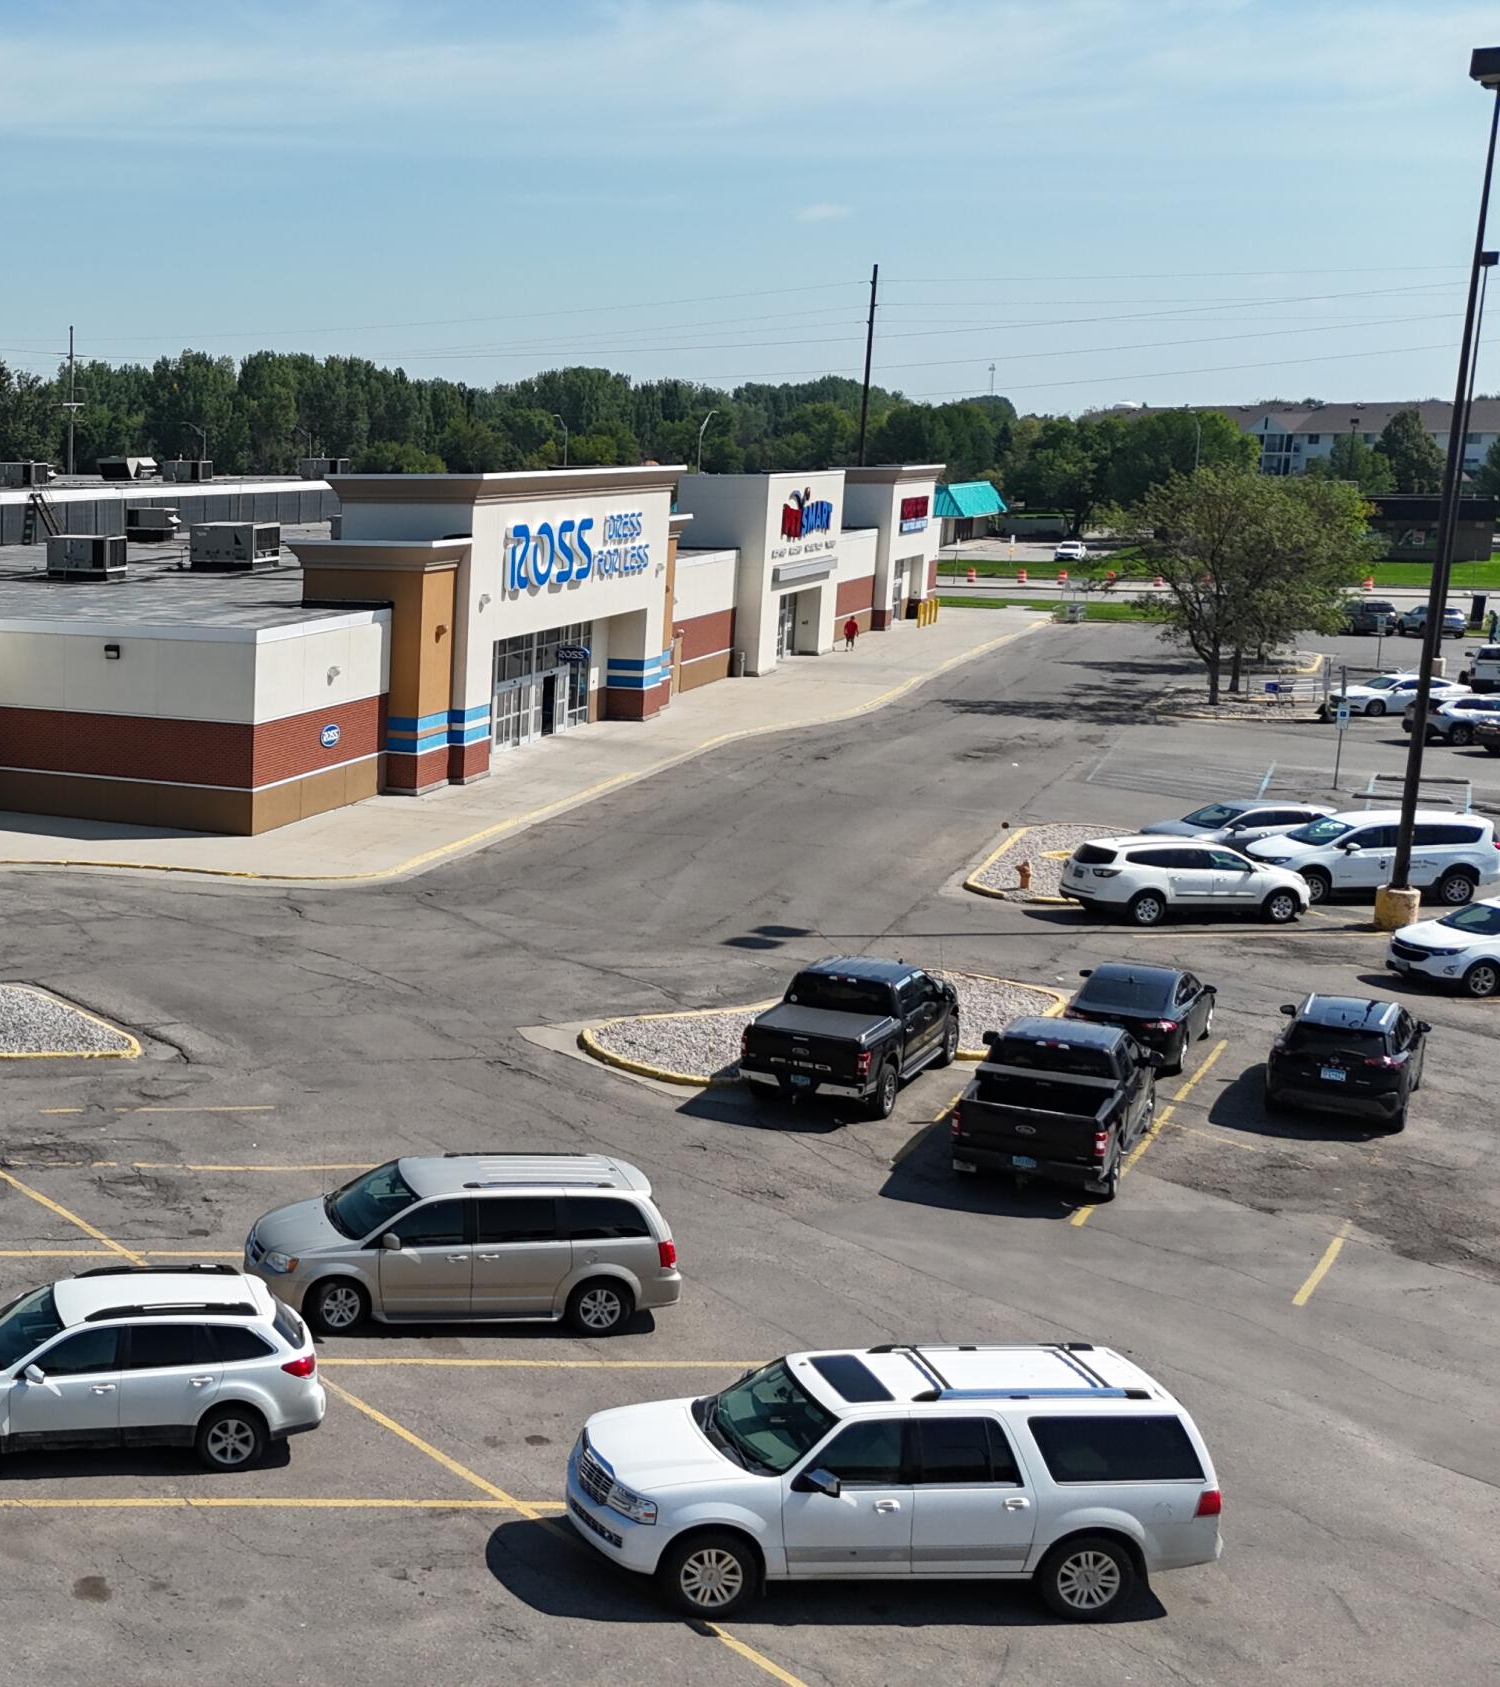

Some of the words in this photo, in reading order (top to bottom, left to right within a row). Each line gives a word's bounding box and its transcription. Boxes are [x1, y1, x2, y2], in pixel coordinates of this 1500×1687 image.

[607, 512, 643, 540] DRESS
[509, 518, 593, 591] ROSS
[596, 548, 620, 576] FOR
[622, 544, 649, 571] LESS
[558, 650, 584, 659] ROSS
